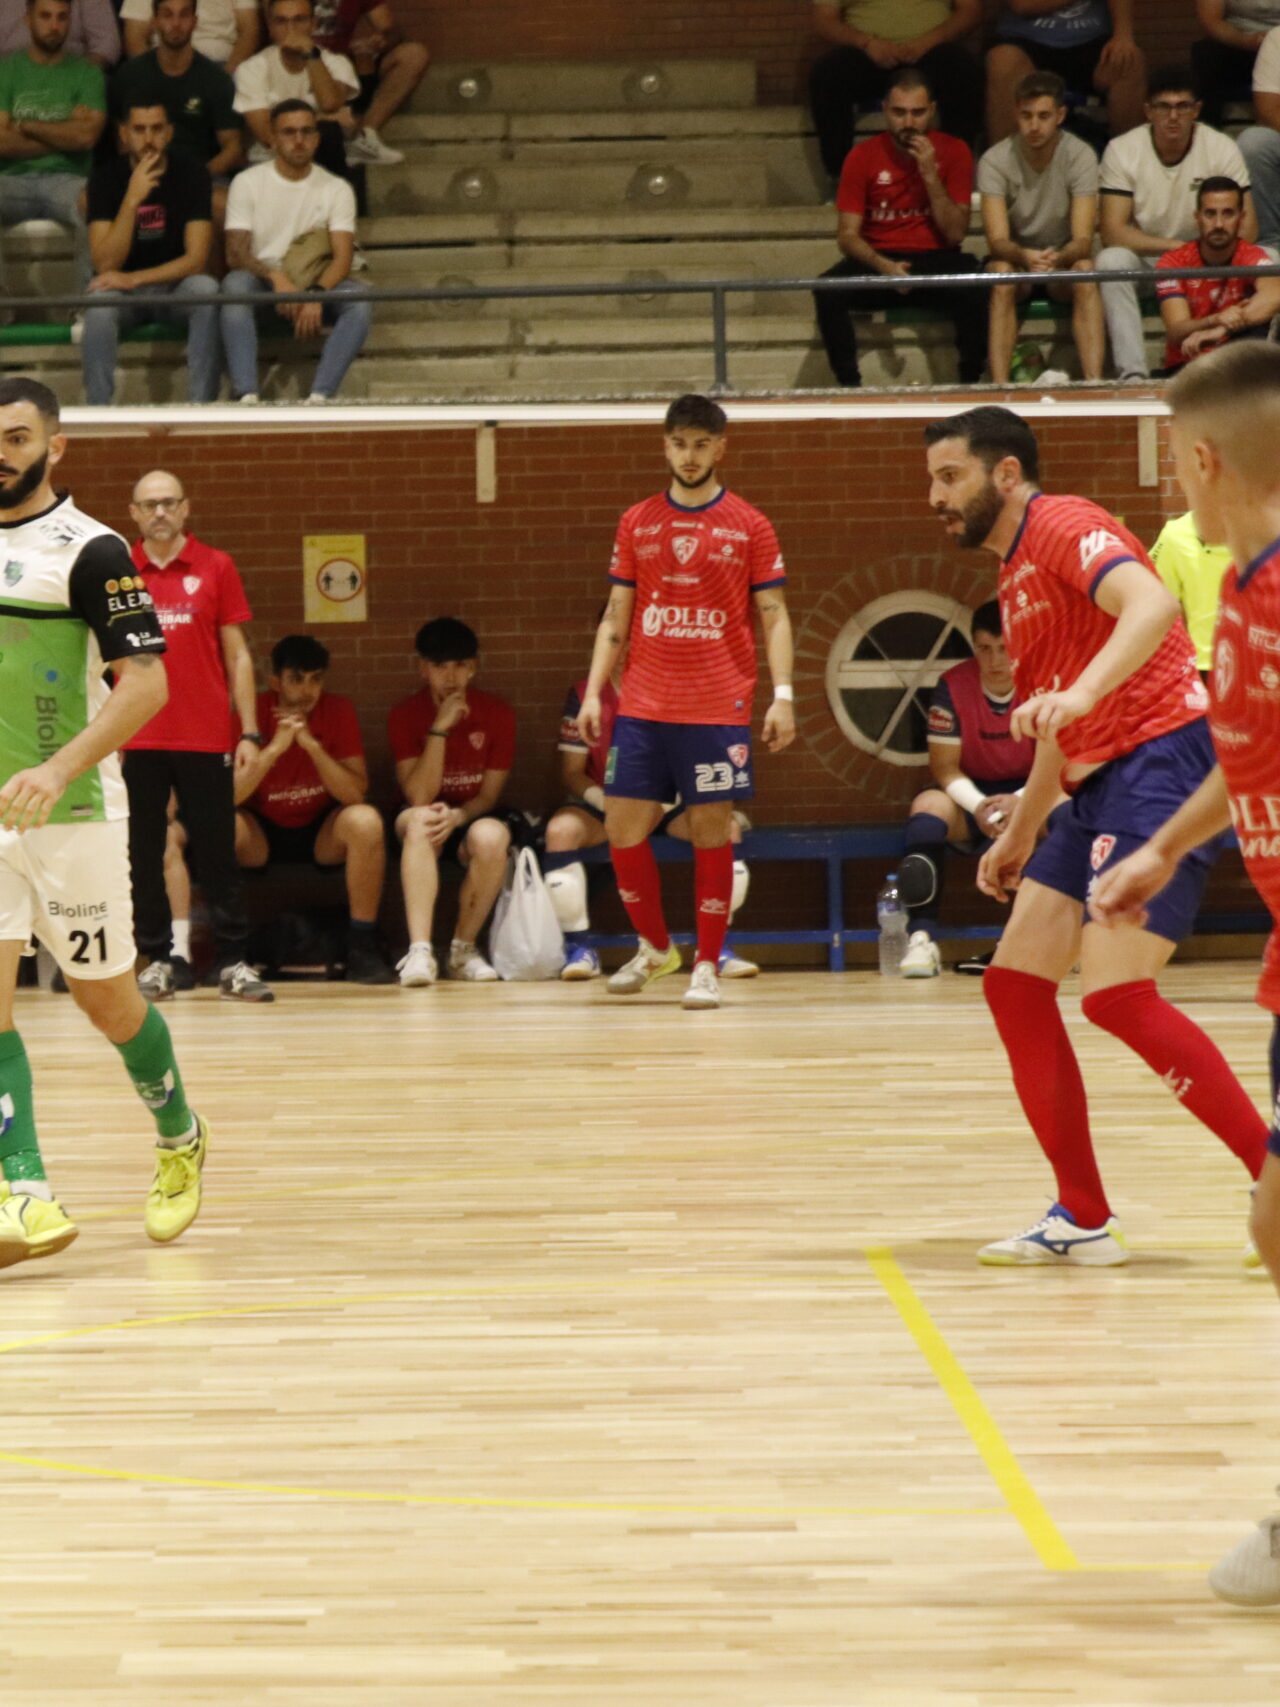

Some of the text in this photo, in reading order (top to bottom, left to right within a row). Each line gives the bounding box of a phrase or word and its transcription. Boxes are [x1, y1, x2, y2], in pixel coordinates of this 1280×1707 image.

[108, 596, 126, 612] EL
[662, 606, 727, 628] OLEO
[694, 762, 734, 792] 23
[48, 901, 107, 918] Bioline
[69, 926, 107, 964] 21
